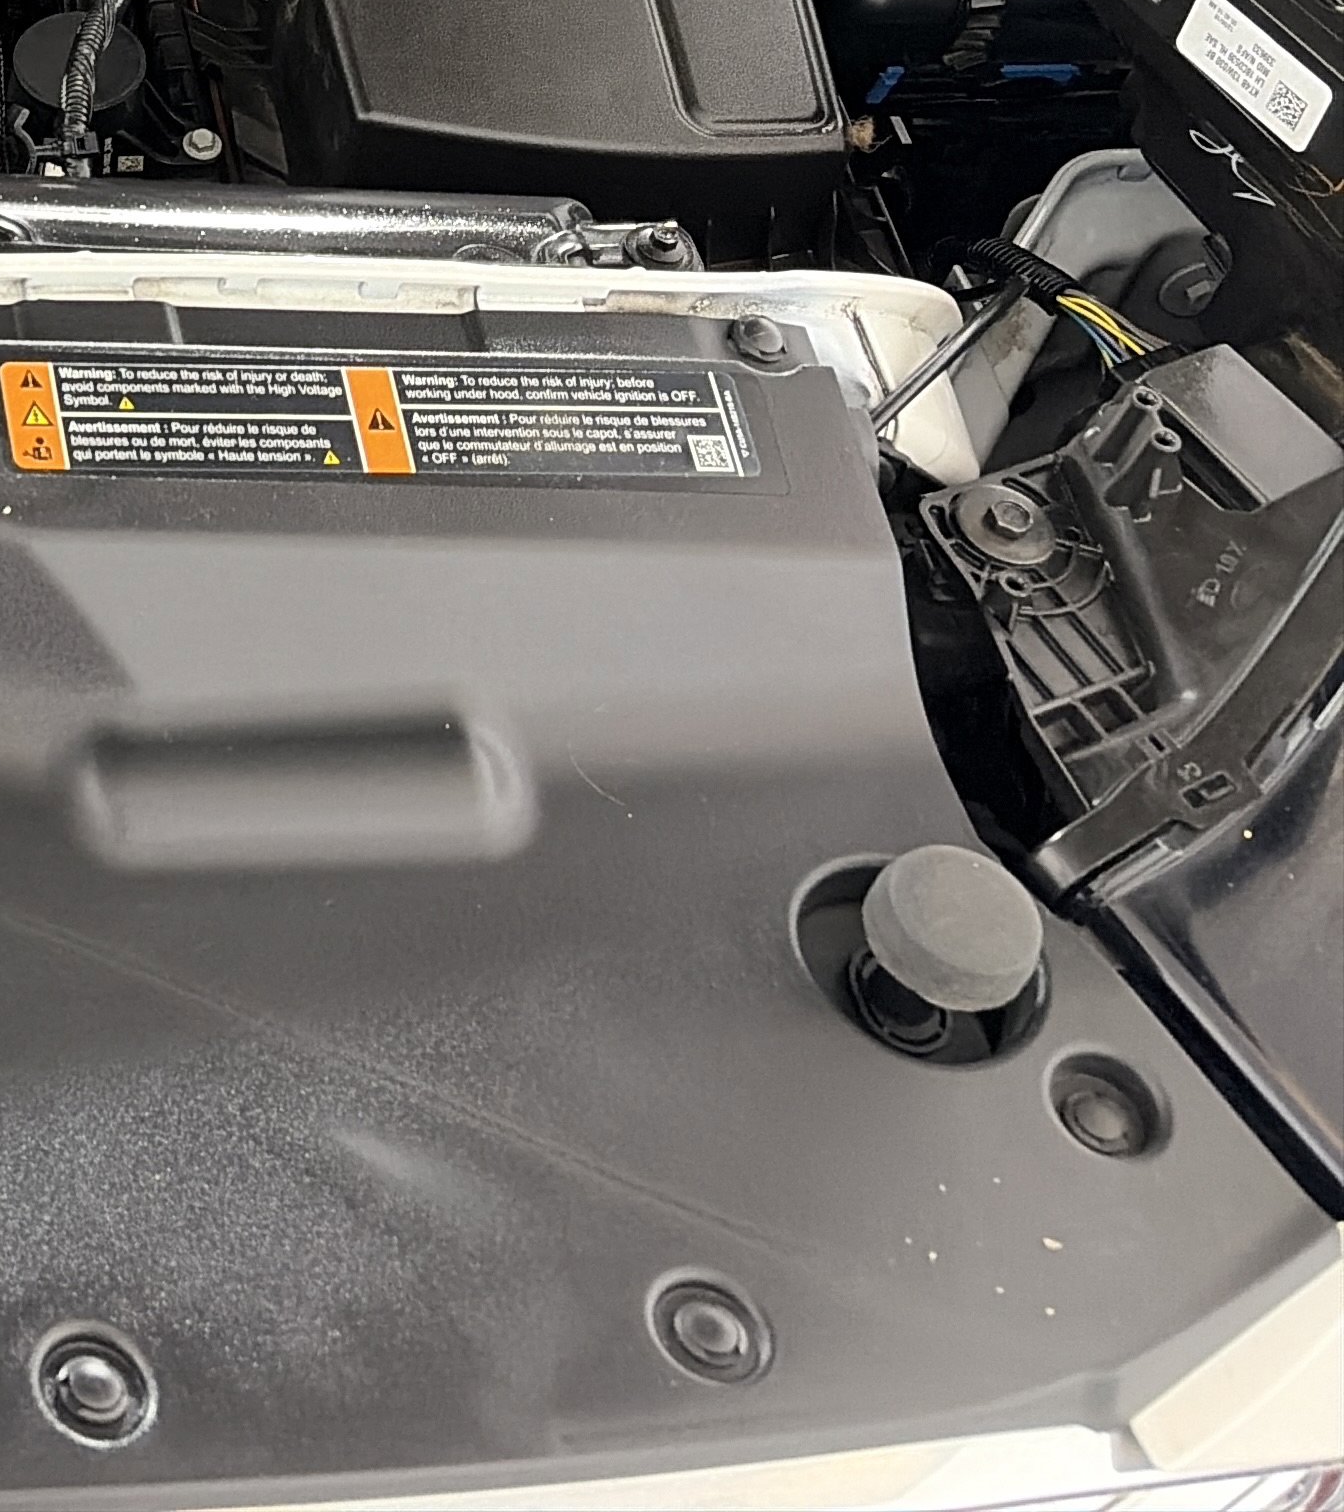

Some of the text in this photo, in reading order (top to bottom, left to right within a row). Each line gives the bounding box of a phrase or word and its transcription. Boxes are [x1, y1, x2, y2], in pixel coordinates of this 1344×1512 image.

[1204, 33, 1265, 88] LH HL SAE
[1256, 63, 1271, 77] MID
[1241, 81, 1259, 98] KT4B
[58, 367, 116, 382] Warning:
[120, 368, 134, 380] To
[136, 369, 177, 380] reduce
[180, 369, 199, 381] the
[202, 370, 224, 381] risk
[226, 370, 237, 381] of
[240, 370, 272, 384] injury
[274, 373, 287, 382] or
[401, 375, 458, 389] Warning:
[461, 375, 475, 386] To
[478, 375, 518, 387] reduce
[520, 376, 539, 387] the
[542, 376, 563, 387] risk
[564, 376, 576, 387] of
[616, 376, 654, 388] before
[61, 381, 342, 398] avoid components marked with the High Voltage
[406, 388, 700, 404] working under hood, confirm vehicle ignition is OFF.
[63, 395, 112, 409] Symbol.
[412, 412, 706, 429] Avertissement Pour réduire le risque de blessures
[68, 421, 316, 437] Avertissement Pour réduire le risque de
[414, 426, 676, 442] lors d'une intervention sous le capot, s'assurer
[70, 435, 330, 451] blessures ou de mort, éviter les composants
[418, 440, 682, 456] que le commutateur d'allumage est en position
[72, 448, 301, 463] qui portent le symbole Haute tension
[431, 452, 514, 465] OFF (arrêt).
